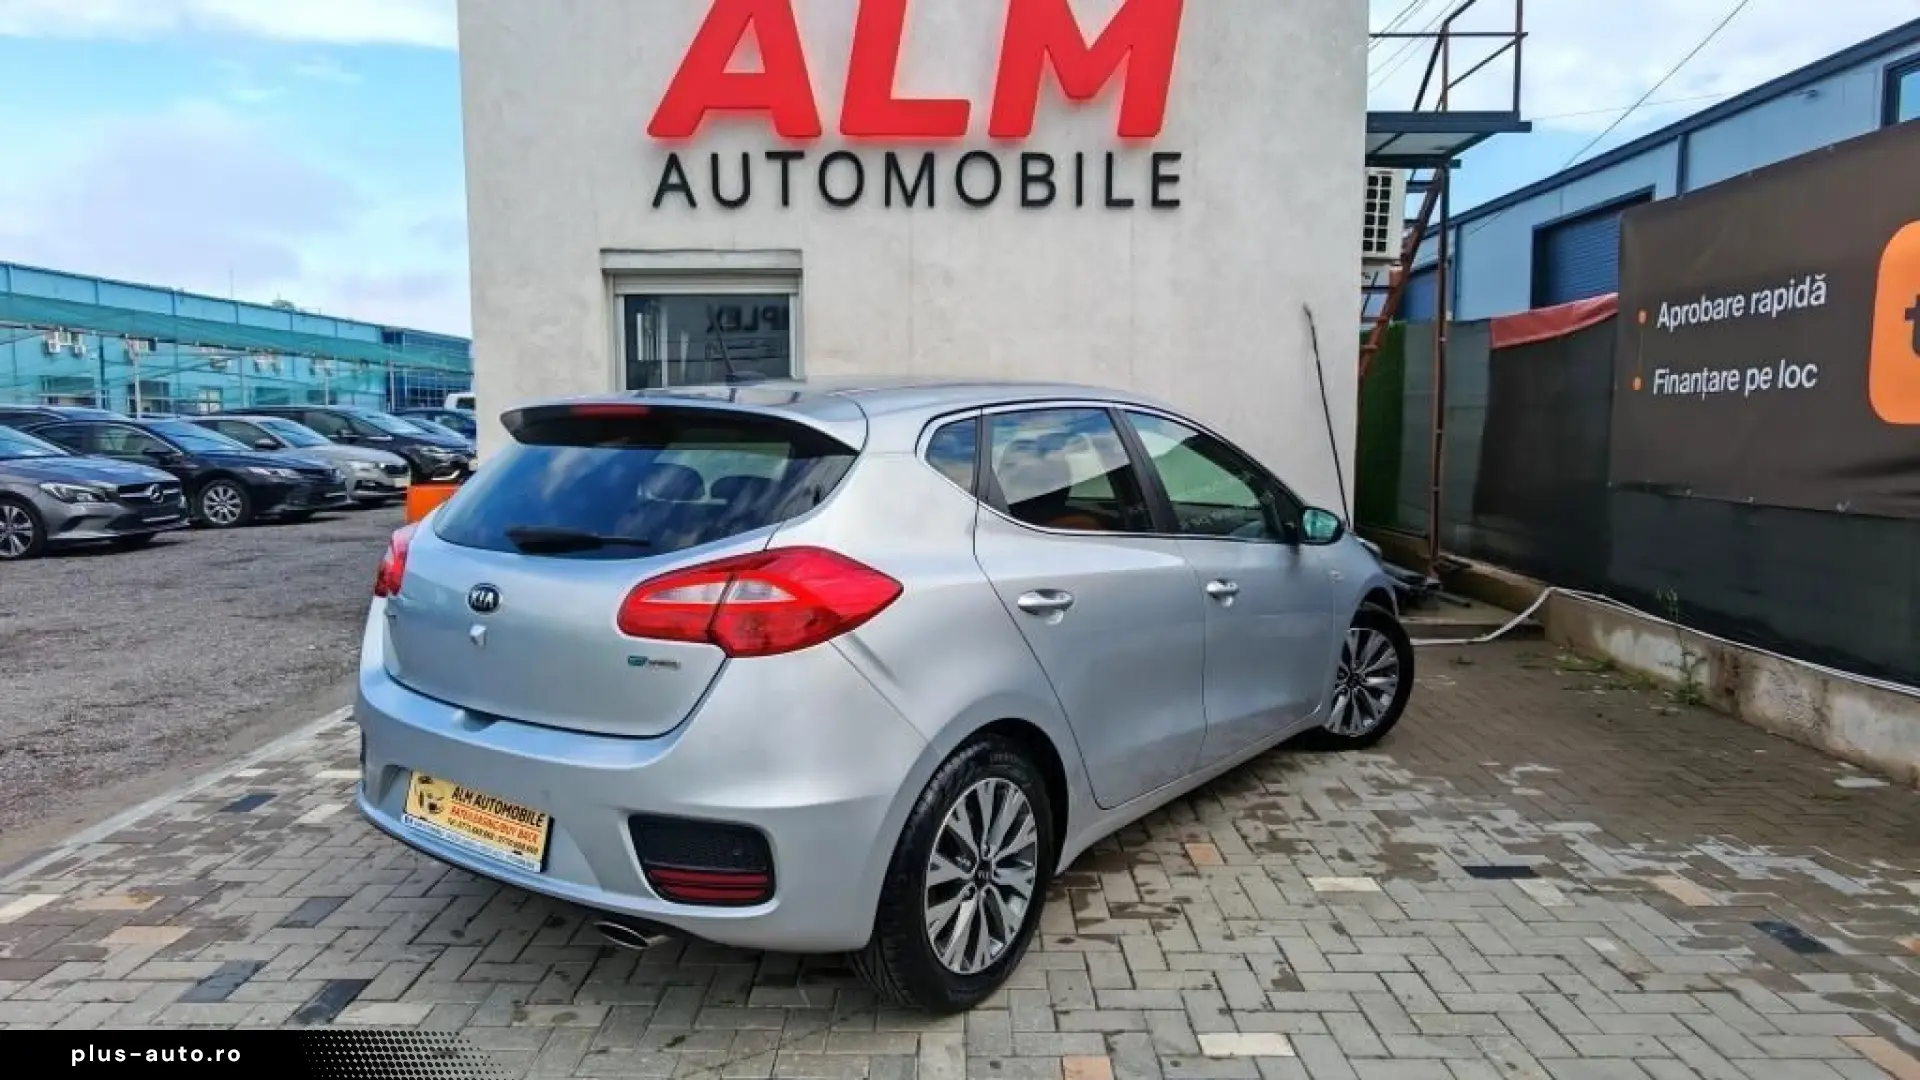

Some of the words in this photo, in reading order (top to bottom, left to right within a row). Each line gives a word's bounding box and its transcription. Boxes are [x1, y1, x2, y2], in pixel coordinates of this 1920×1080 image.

[647, 0, 1184, 138] ALM
[652, 150, 1182, 208] AUTOMOBILE
[1657, 294, 1746, 332] Aprobare
[1750, 274, 1828, 317] rapidă
[1653, 367, 1739, 399] Finanțare
[1744, 364, 1773, 396] pe
[1778, 359, 1818, 389] loc
[451, 786, 474, 805] ALM
[474, 794, 546, 827] AUTOMOBILE
